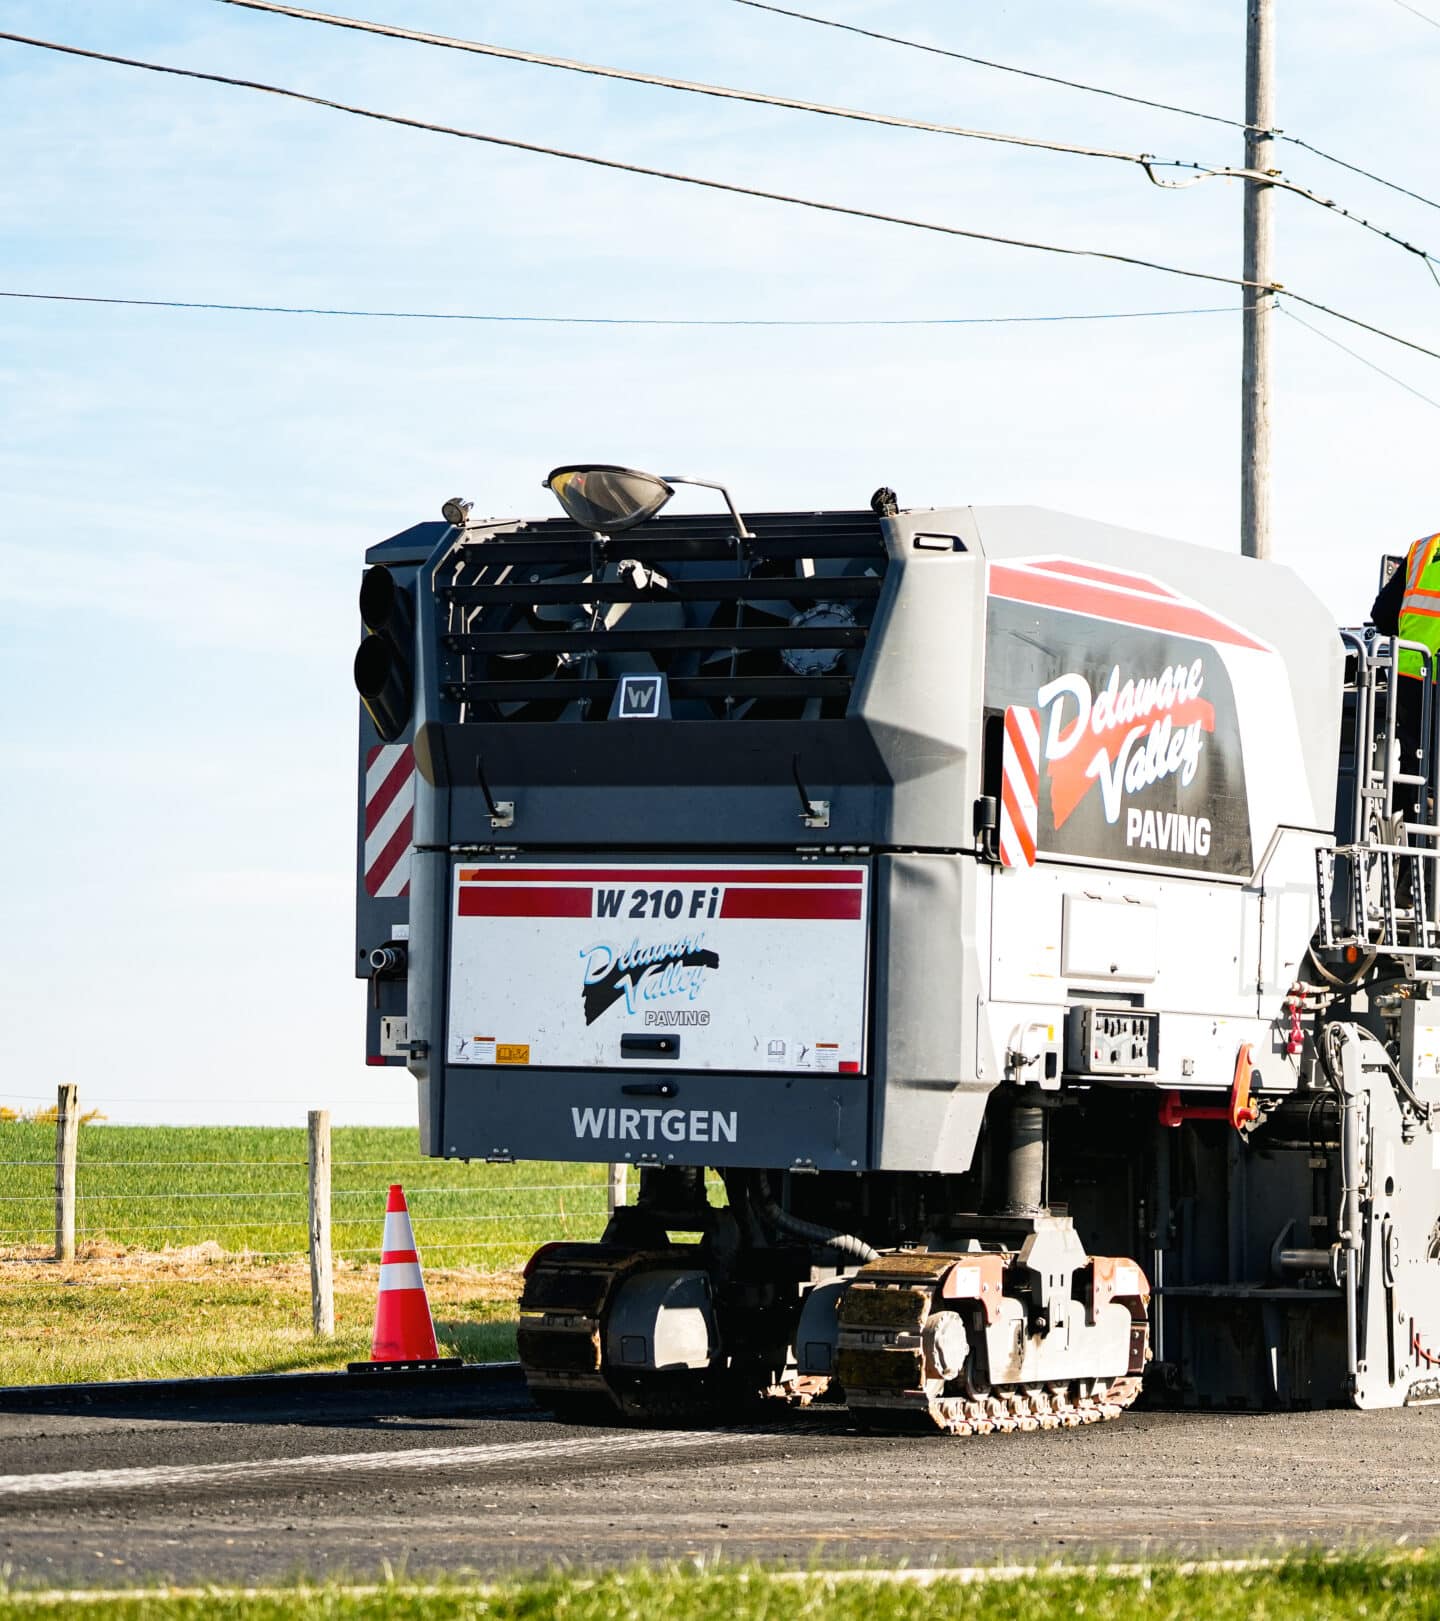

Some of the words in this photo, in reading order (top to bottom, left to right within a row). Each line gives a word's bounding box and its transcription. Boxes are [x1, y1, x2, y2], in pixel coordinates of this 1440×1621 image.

[627, 686, 655, 708] W
[1037, 658, 1204, 760] Delaware
[1085, 714, 1203, 824] Valley
[1126, 808, 1212, 856] PAVING
[596, 889, 625, 918] W
[628, 889, 684, 919] 210
[688, 887, 720, 918] Fi
[579, 933, 706, 985] Delaware
[613, 960, 706, 1015] Valley
[644, 1010, 711, 1026] PAVING
[571, 1107, 738, 1143] WIRTGEN
